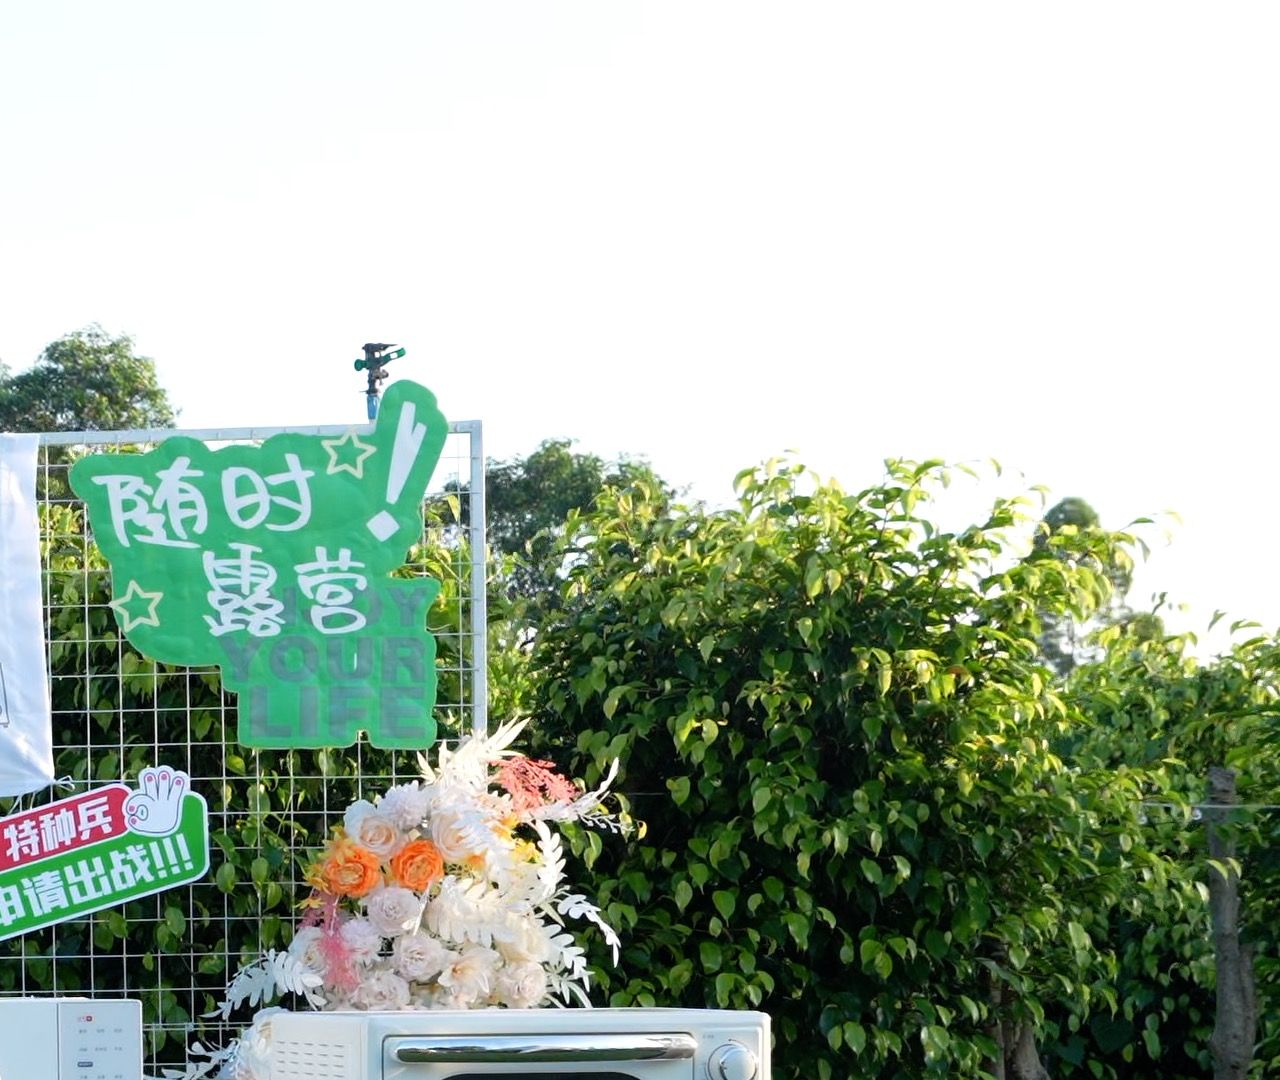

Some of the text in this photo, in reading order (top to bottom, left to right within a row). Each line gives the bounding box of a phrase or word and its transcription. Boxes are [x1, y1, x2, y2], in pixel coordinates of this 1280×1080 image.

[92, 454, 315, 548] 随时
[203, 542, 367, 637] 露营
[218, 635, 425, 683] YOUR
[251, 685, 425, 738] LIFE
[3, 796, 113, 862] 特种兵
